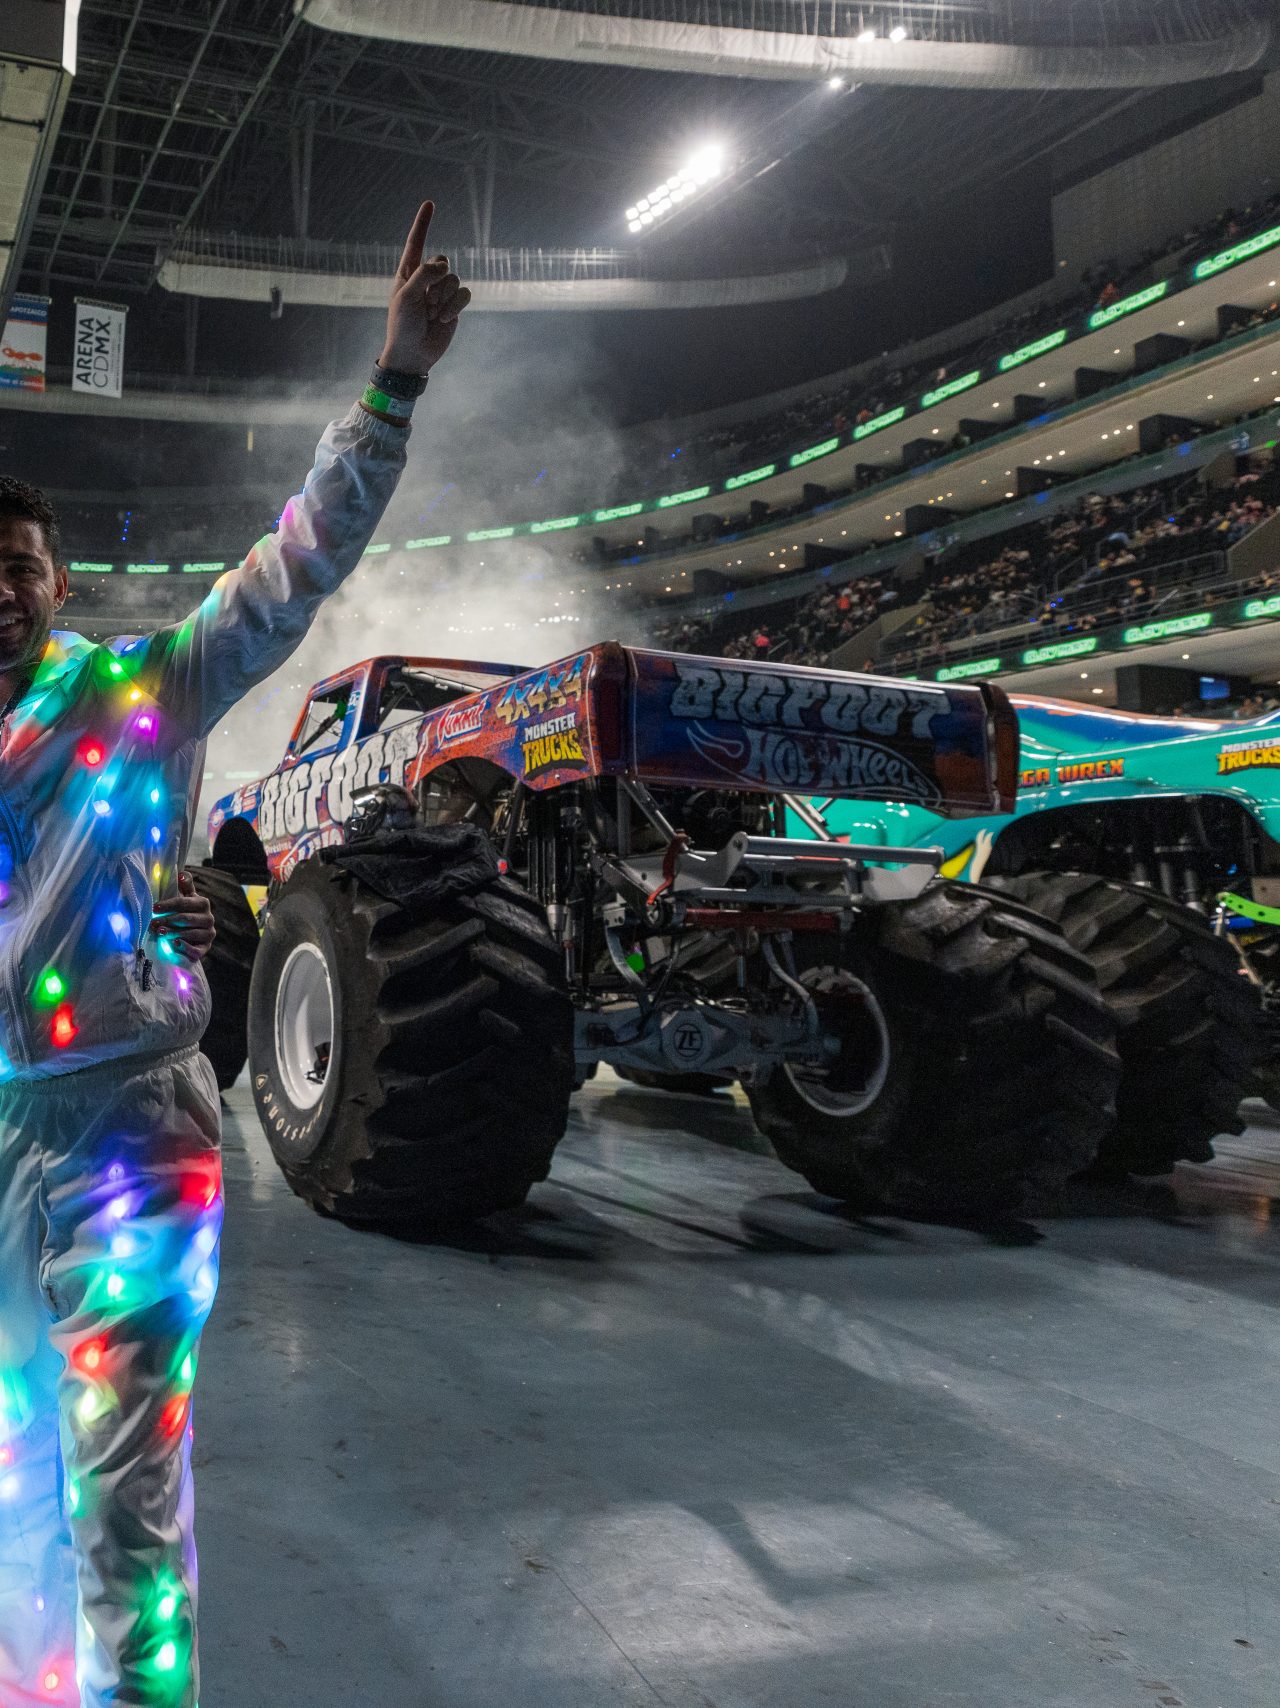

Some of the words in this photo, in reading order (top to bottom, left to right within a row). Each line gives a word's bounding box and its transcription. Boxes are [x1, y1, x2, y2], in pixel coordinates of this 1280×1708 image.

[75, 317, 95, 386] ARENA
[92, 318, 111, 388] CDMX
[670, 661, 952, 739] BIGFOOT
[524, 711, 576, 740] MONSTER
[521, 729, 587, 775] TRUCKS
[1057, 758, 1125, 783] WREX
[1216, 745, 1280, 773] TRUCKS
[259, 719, 423, 842] BIGFOOT
[677, 1028, 702, 1050] ZF
